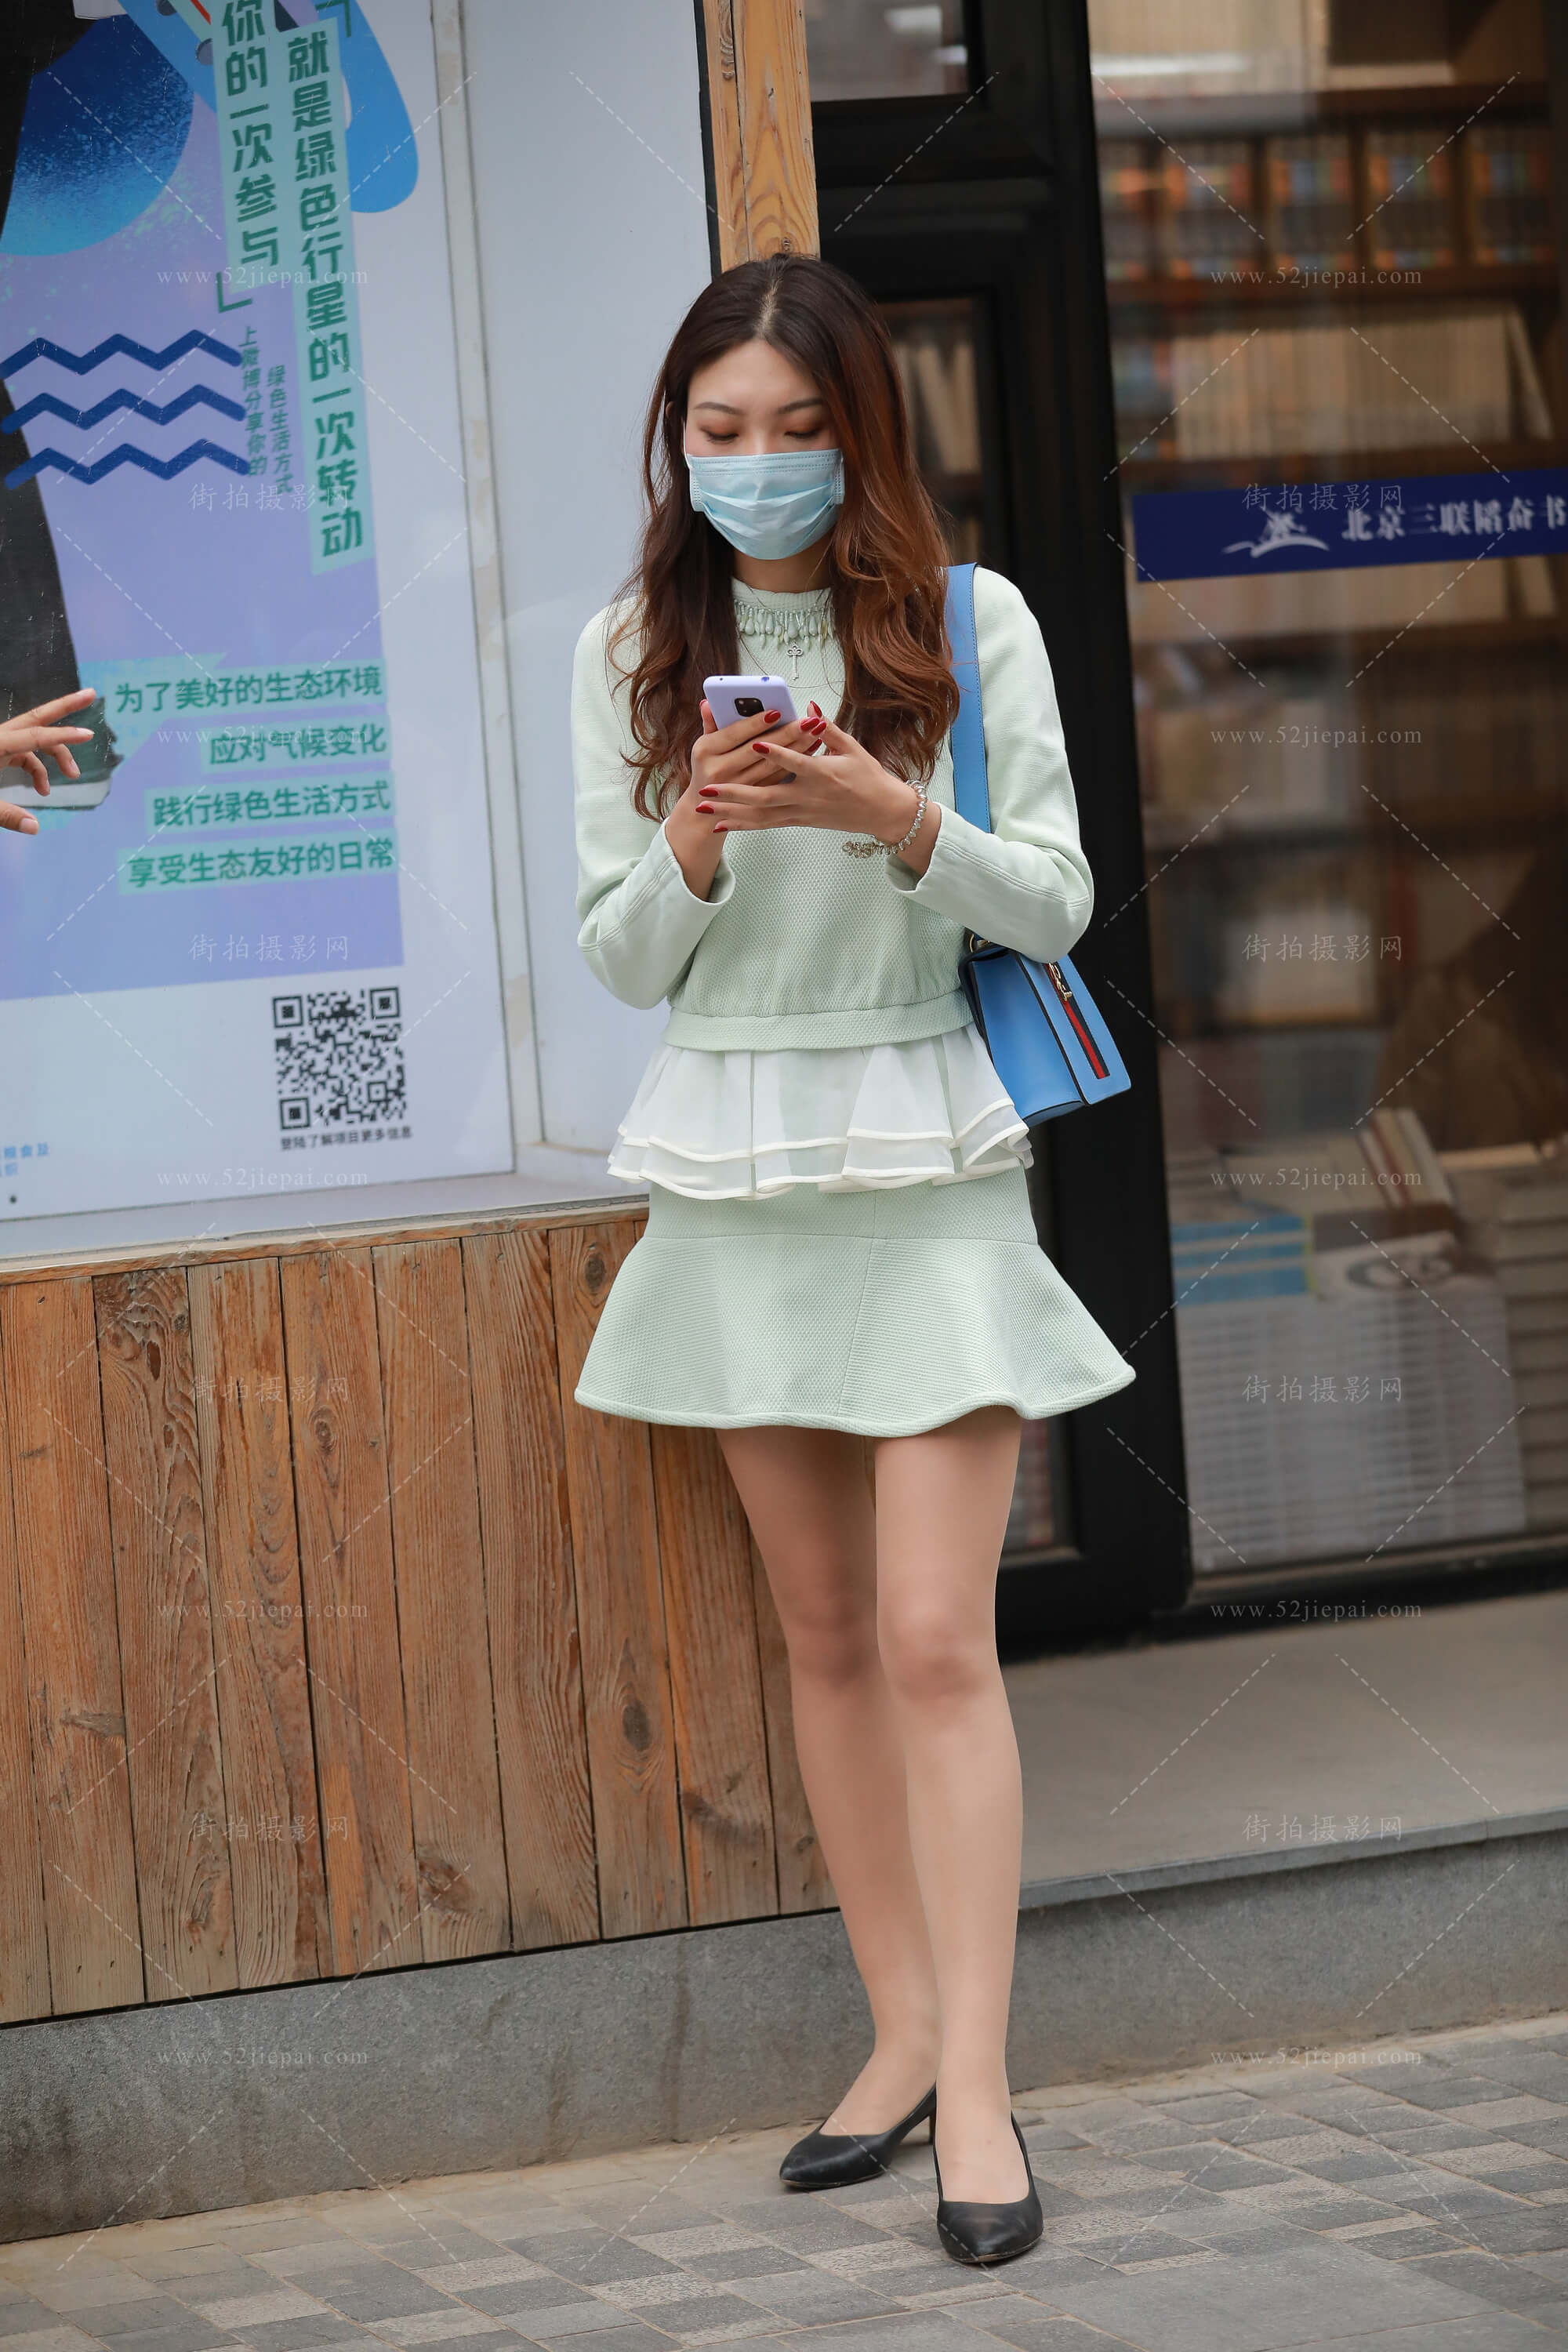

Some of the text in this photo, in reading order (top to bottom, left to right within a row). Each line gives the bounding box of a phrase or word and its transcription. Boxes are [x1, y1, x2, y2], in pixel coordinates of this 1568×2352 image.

[222, 0, 279, 267] 你的一次参与
[288, 30, 363, 557] 就是绿色行星的一次转动
[238, 325, 268, 477] 上微博分享你的
[267, 364, 294, 495] 绿色生活方式
[114, 665, 383, 714] 为了美好的生态环境
[209, 723, 388, 765] 应对气候变化
[153, 779, 391, 827] 践行绿色生活方式
[126, 837, 395, 889] 享受生态友好的日常
